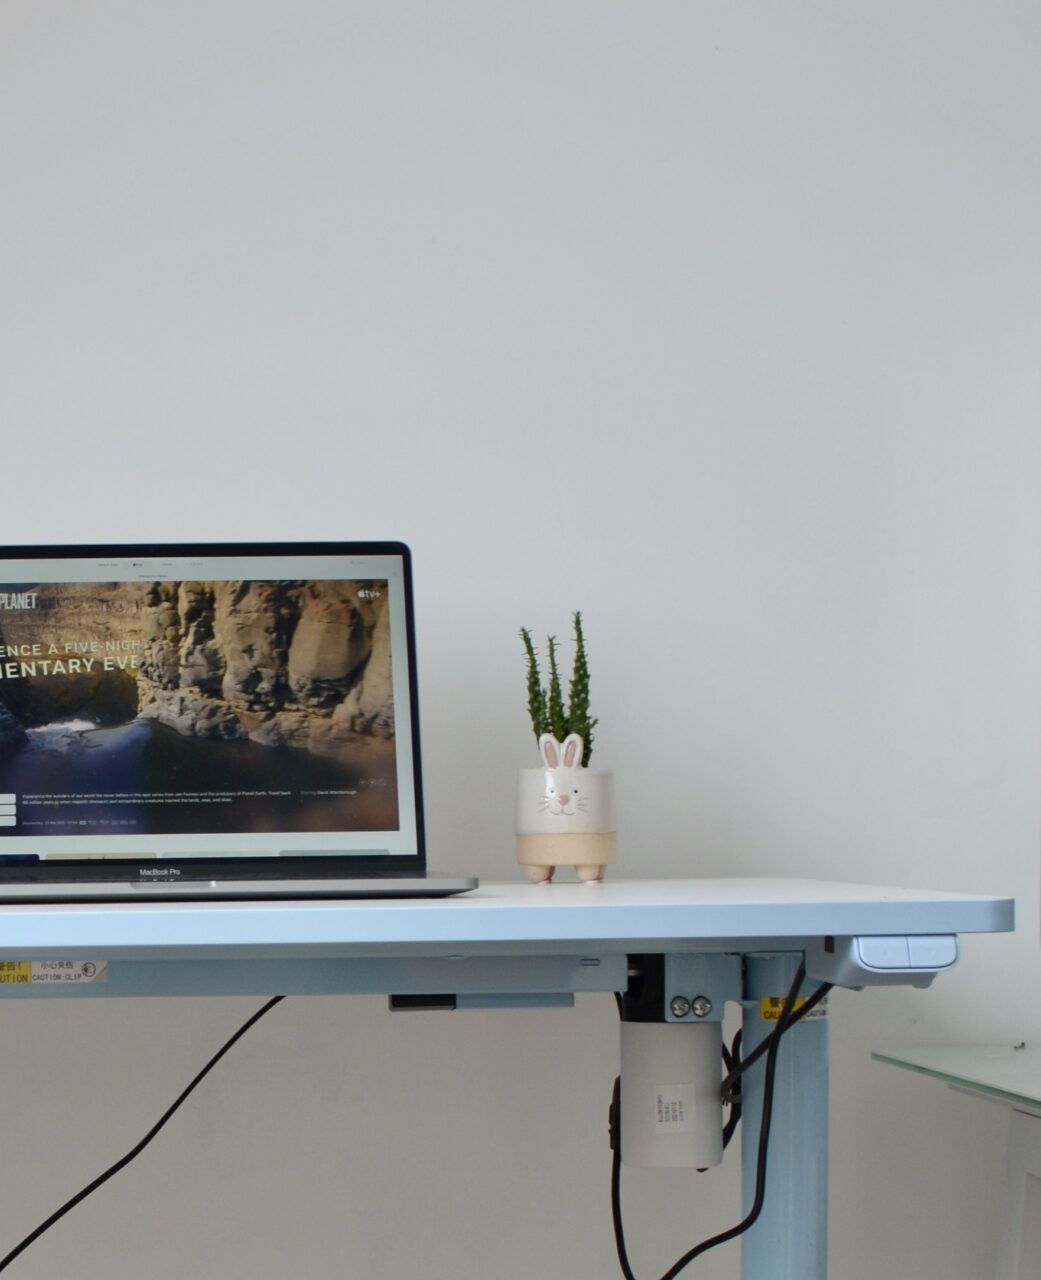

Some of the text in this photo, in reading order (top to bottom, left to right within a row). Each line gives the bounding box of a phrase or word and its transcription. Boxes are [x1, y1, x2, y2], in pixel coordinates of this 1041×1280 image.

[48, 644, 59, 655] A
[140, 868, 181, 876] MacBook Pro
